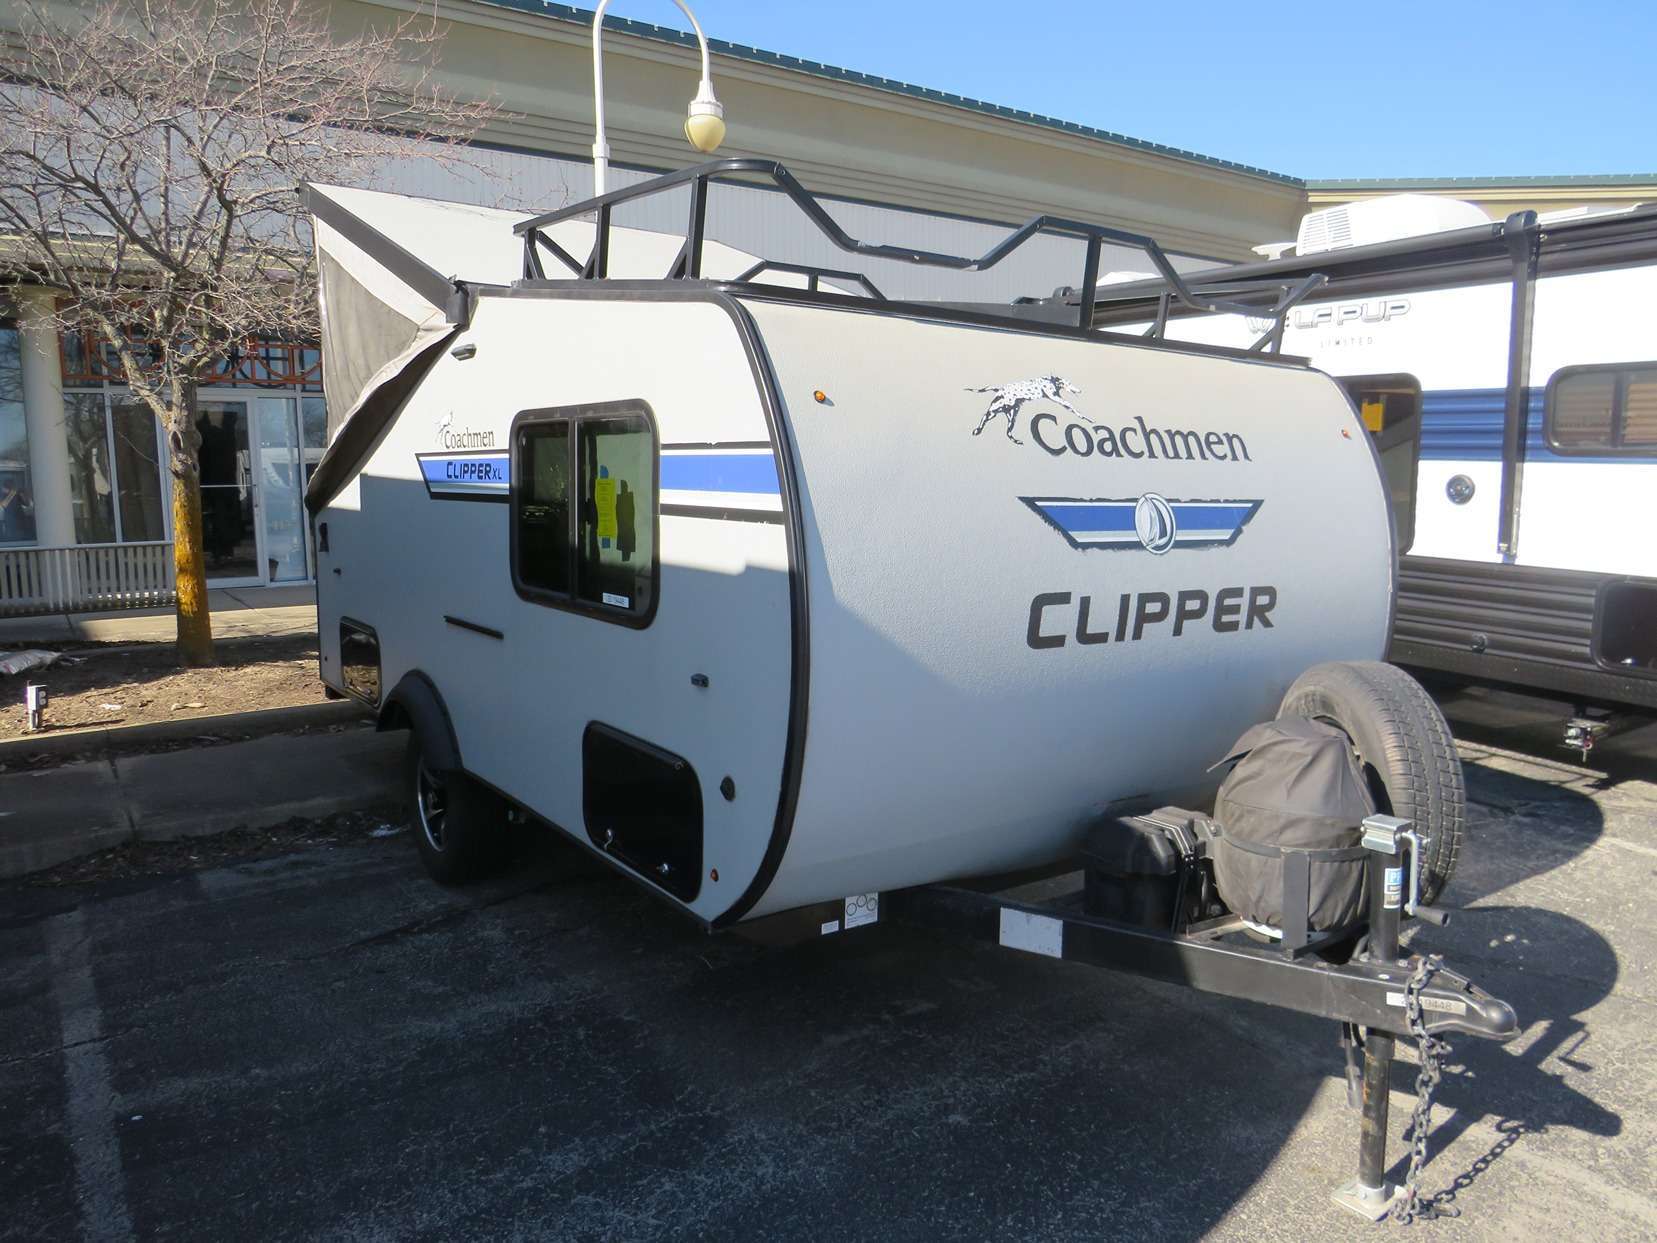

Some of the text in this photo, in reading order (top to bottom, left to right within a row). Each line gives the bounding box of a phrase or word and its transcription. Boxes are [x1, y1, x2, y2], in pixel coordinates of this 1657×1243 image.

[1336, 299, 1411, 327] PUP
[444, 426, 495, 449] Coachmen
[1030, 412, 1252, 462] Coachmen
[446, 461, 491, 481] CLIPPER
[1026, 585, 1277, 650] CLIPPER
